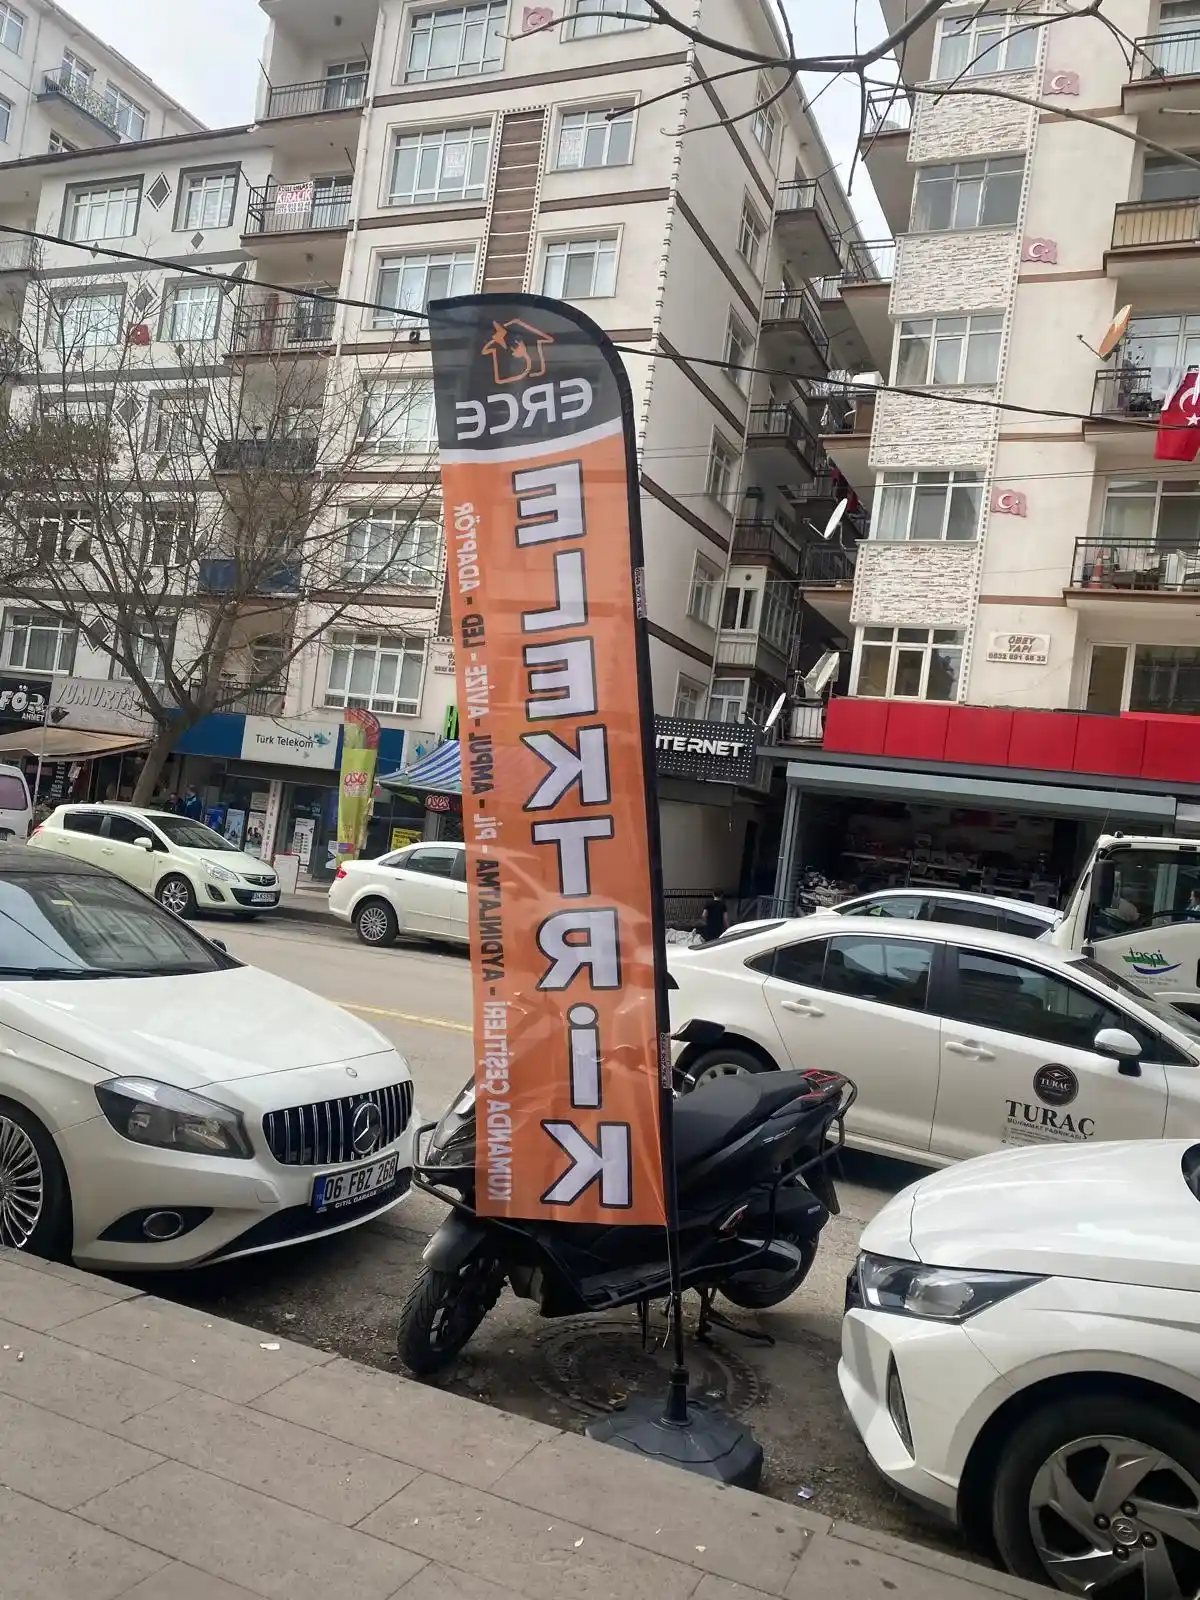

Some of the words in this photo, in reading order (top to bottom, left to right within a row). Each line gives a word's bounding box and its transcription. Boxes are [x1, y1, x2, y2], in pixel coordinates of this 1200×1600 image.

[21, 713, 45, 722] AHMET
[256, 733, 274, 745] Türk
[277, 736, 314, 749] Telekom
[1005, 1099, 1095, 1140] TURAÇ
[324, 1176, 344, 1201] 06
[347, 1167, 375, 1196] FBZ
